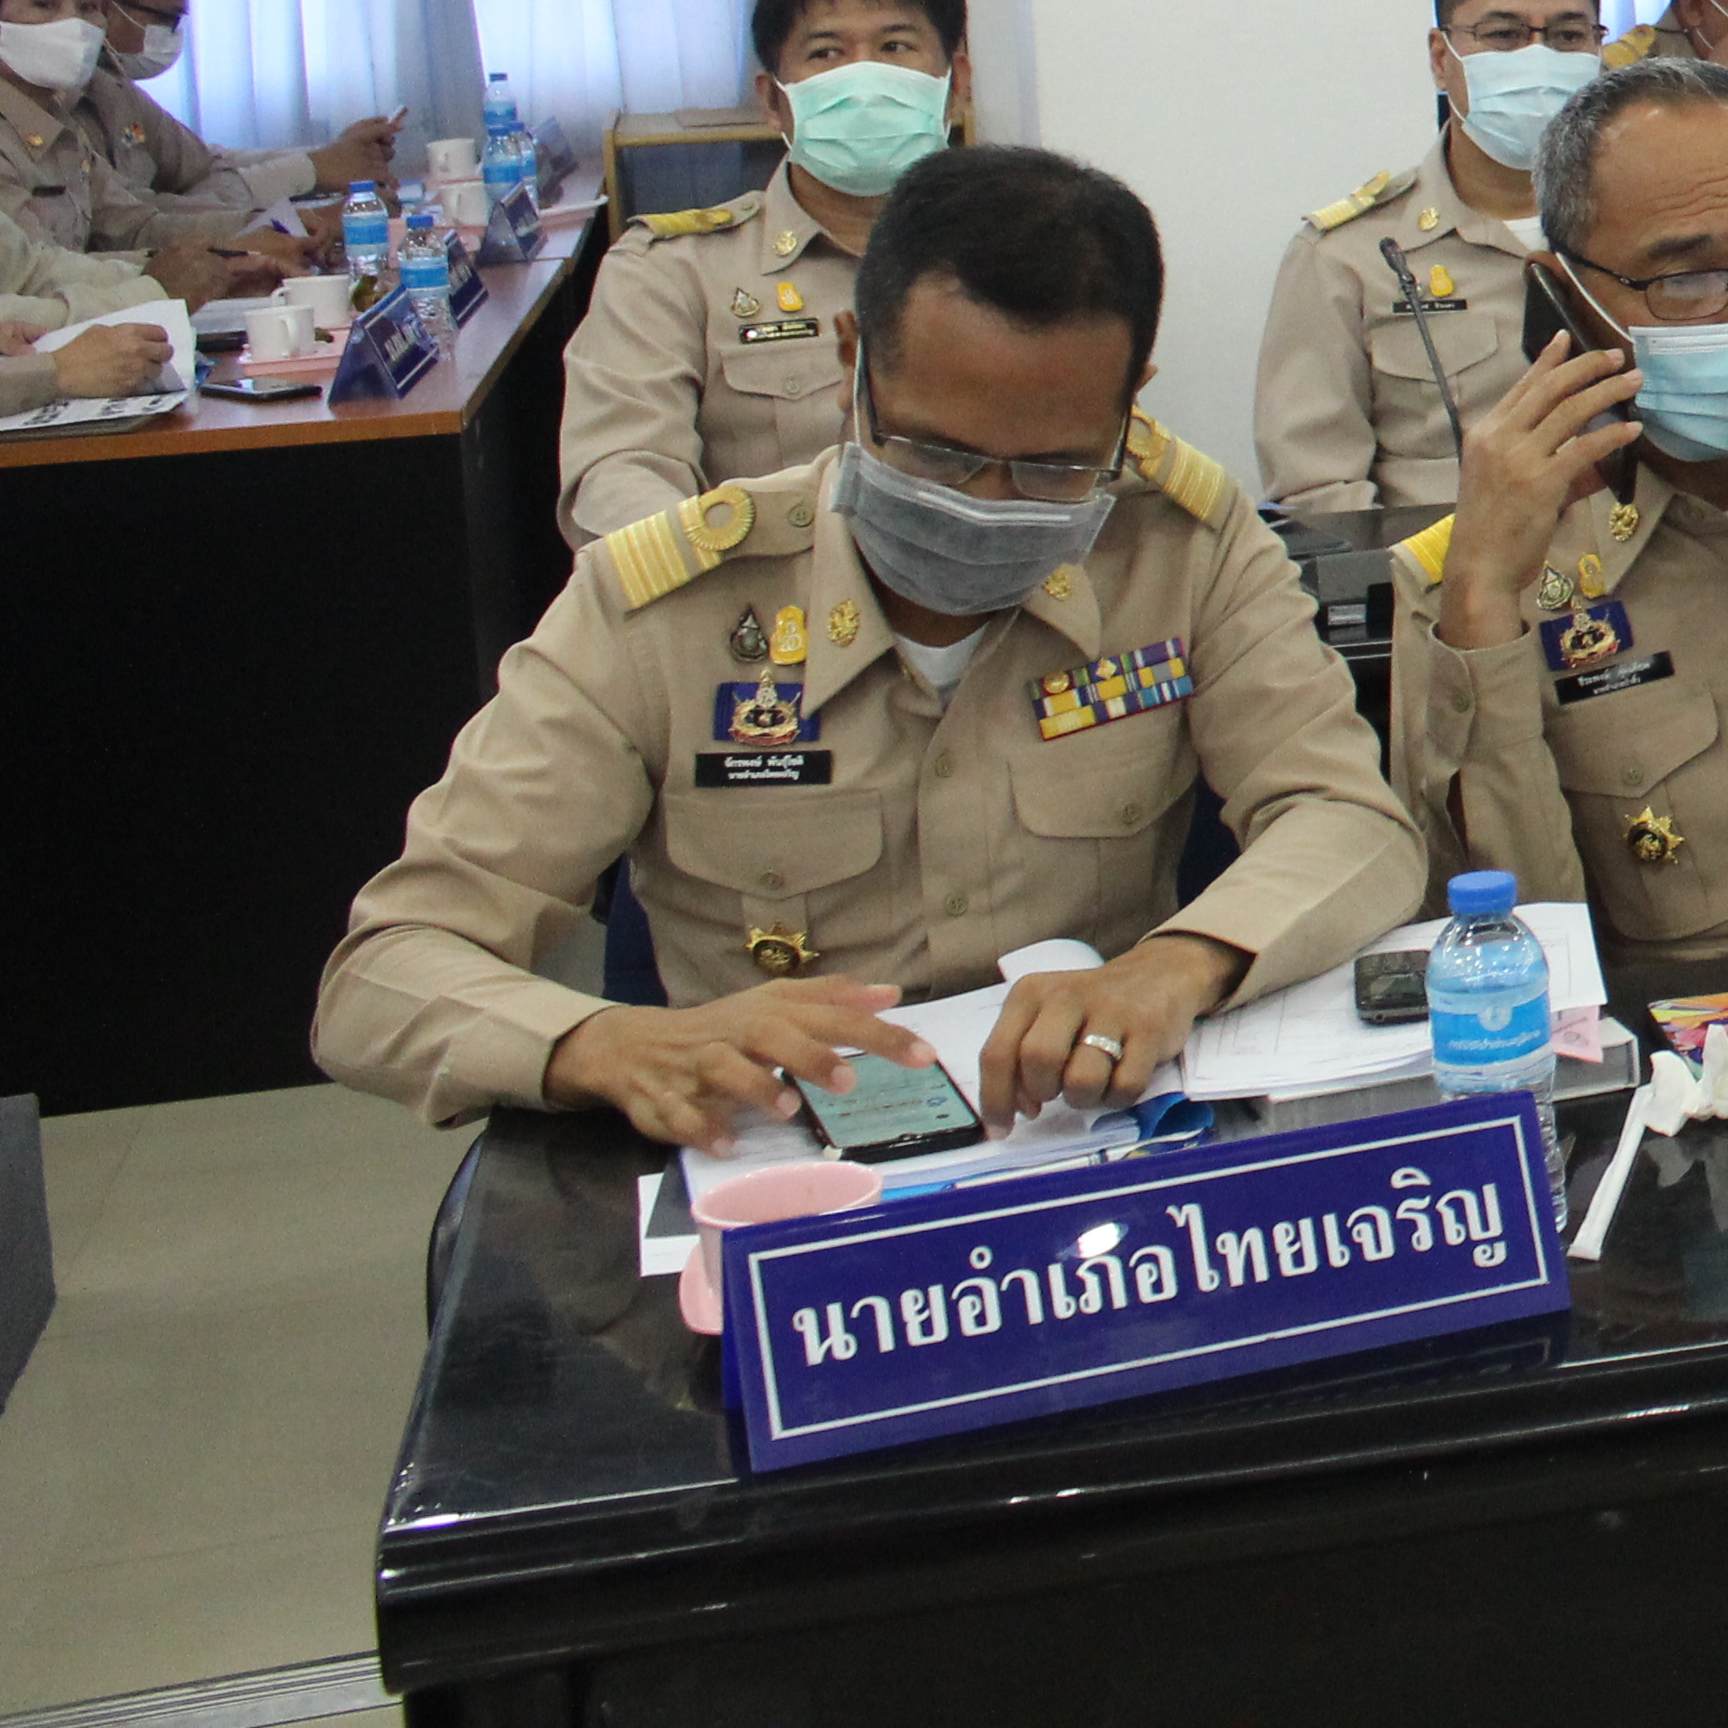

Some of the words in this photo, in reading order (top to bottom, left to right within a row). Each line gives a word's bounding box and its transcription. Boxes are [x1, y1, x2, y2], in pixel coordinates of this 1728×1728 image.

[792, 1169, 1506, 1369] นายอำเภอไทยเจริญ
